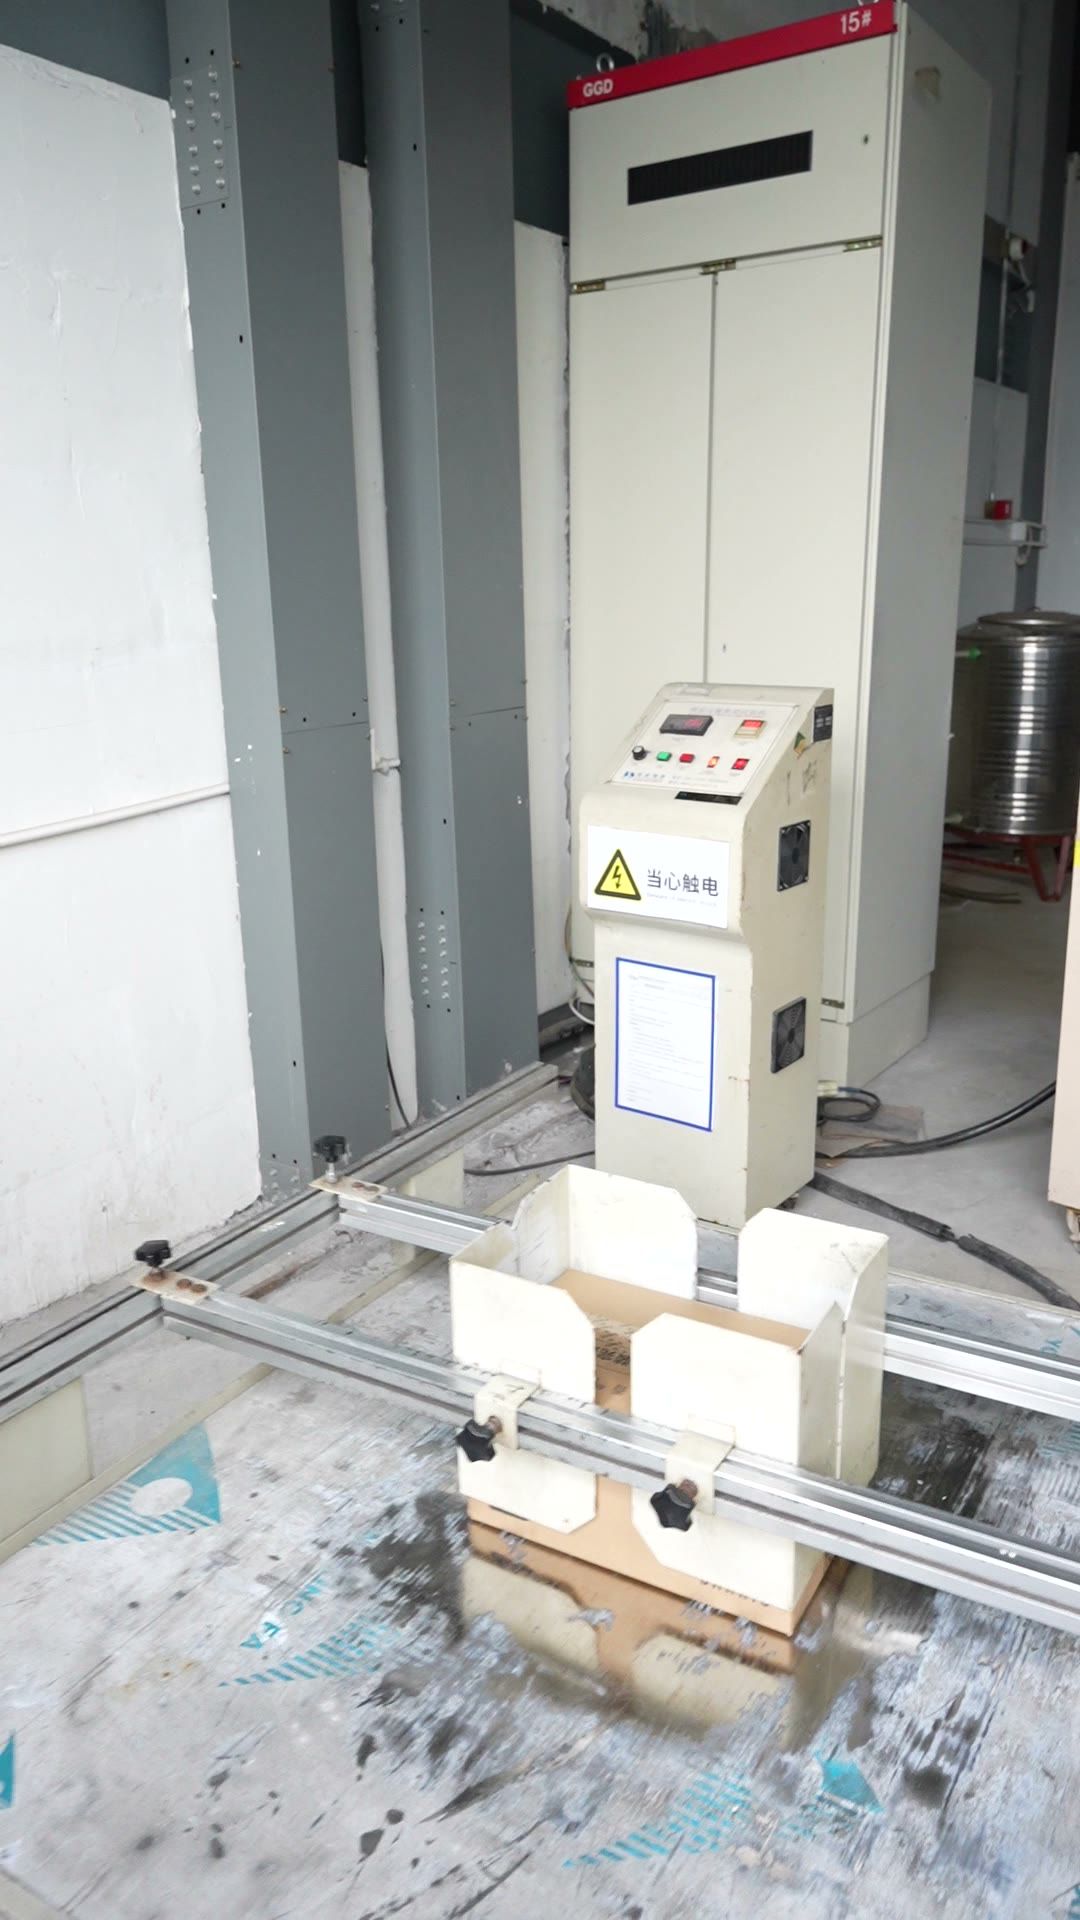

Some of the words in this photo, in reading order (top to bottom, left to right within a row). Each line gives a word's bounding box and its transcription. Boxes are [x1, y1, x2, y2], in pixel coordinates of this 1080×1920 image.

[840, 9, 872, 35] 15#
[582, 78, 614, 97] GGD
[647, 868, 719, 897] 当心触电
